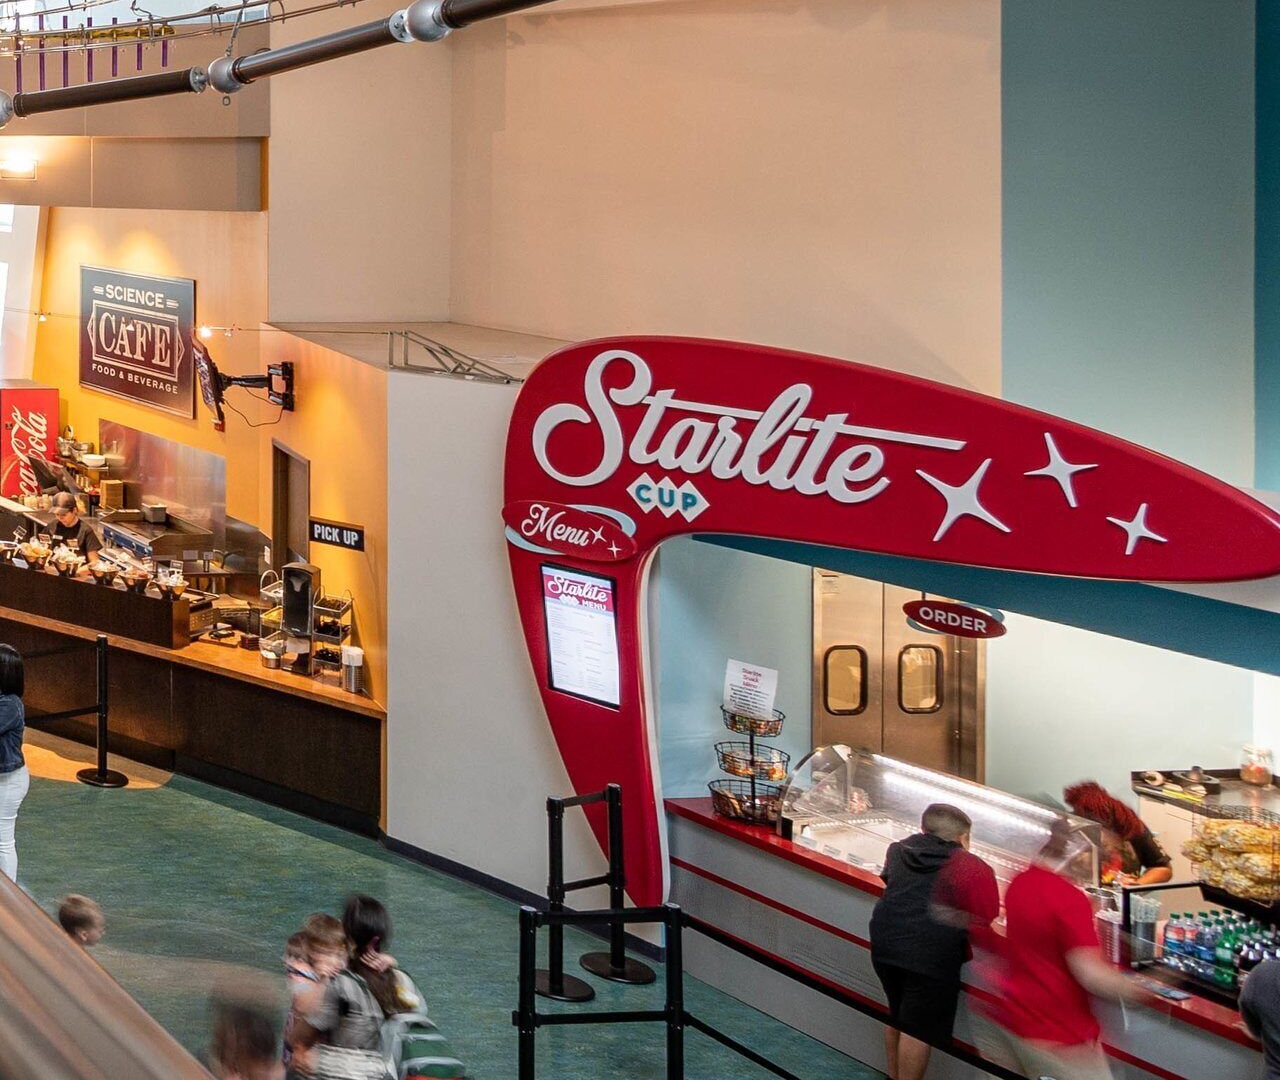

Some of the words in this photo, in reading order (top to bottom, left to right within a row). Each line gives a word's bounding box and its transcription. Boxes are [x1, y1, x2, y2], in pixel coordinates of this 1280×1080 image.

[105, 284, 165, 309] SCIENCE
[92, 363, 116, 377] FOOD
[119, 371, 125, 380] &
[127, 373, 179, 395] BEVERAGE
[532, 349, 967, 504] Starlite
[634, 482, 699, 512] CUP
[314, 524, 340, 543] PICK
[343, 529, 359, 547] UP
[521, 503, 591, 548] Menu
[547, 575, 613, 603] Starlite
[919, 606, 988, 634] ORDER
